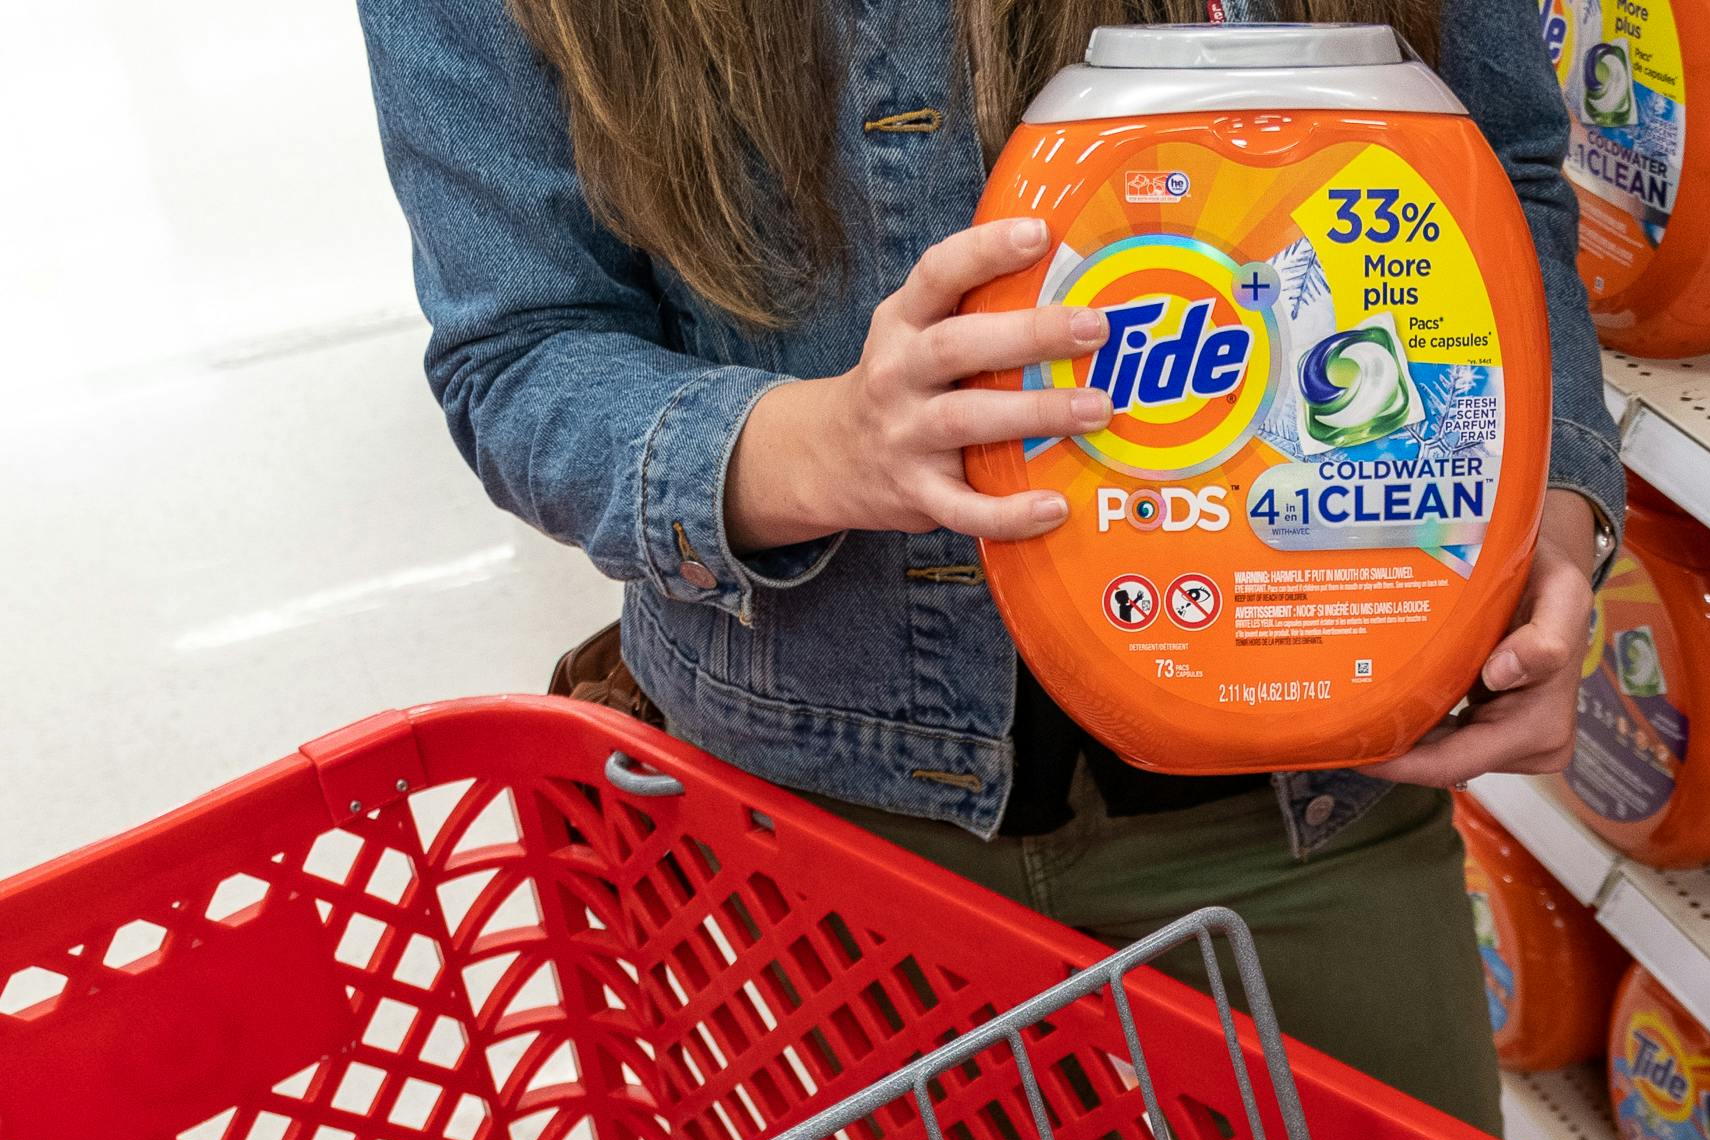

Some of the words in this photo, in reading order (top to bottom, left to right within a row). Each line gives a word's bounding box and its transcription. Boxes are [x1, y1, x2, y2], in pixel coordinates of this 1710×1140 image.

[1615, 16, 1641, 39] plus
[1588, 131, 1668, 178] COLDWATER
[1588, 148, 1667, 210] CLEAN
[1327, 189, 1440, 243] 33%
[1364, 254, 1431, 278] More
[1363, 283, 1418, 310] plus
[1408, 335, 1426, 348] de
[1091, 299, 1250, 410] Tide
[1456, 409, 1496, 420] SCENT
[1457, 398, 1496, 409] FRESH
[1445, 420, 1496, 432] PARFUM
[1460, 430, 1496, 442] FRAIS
[1318, 457, 1482, 481] COLDWATER
[1098, 486, 1229, 533] PODS
[1249, 488, 1280, 525] 4
[1318, 482, 1483, 522] CLEAN
[1234, 571, 1270, 583] WARNING:
[1271, 570, 1304, 582] HARMFUL
[1305, 570, 1311, 582] IF
[1312, 569, 1325, 582] PUT
[1326, 569, 1334, 581] IN
[1334, 568, 1358, 581] MOUTH
[1360, 568, 1369, 580] OR
[1370, 567, 1414, 579] SWALLOWED.
[1154, 659, 1174, 678] 73
[1219, 683, 1239, 702] 2.11
[1241, 683, 1256, 705] kg
[1258, 681, 1280, 702] (4.62
[1282, 680, 1300, 703] LB)
[1302, 683, 1317, 699] 74
[1319, 681, 1331, 699] OZ
[1632, 1029, 1688, 1100] Tide
